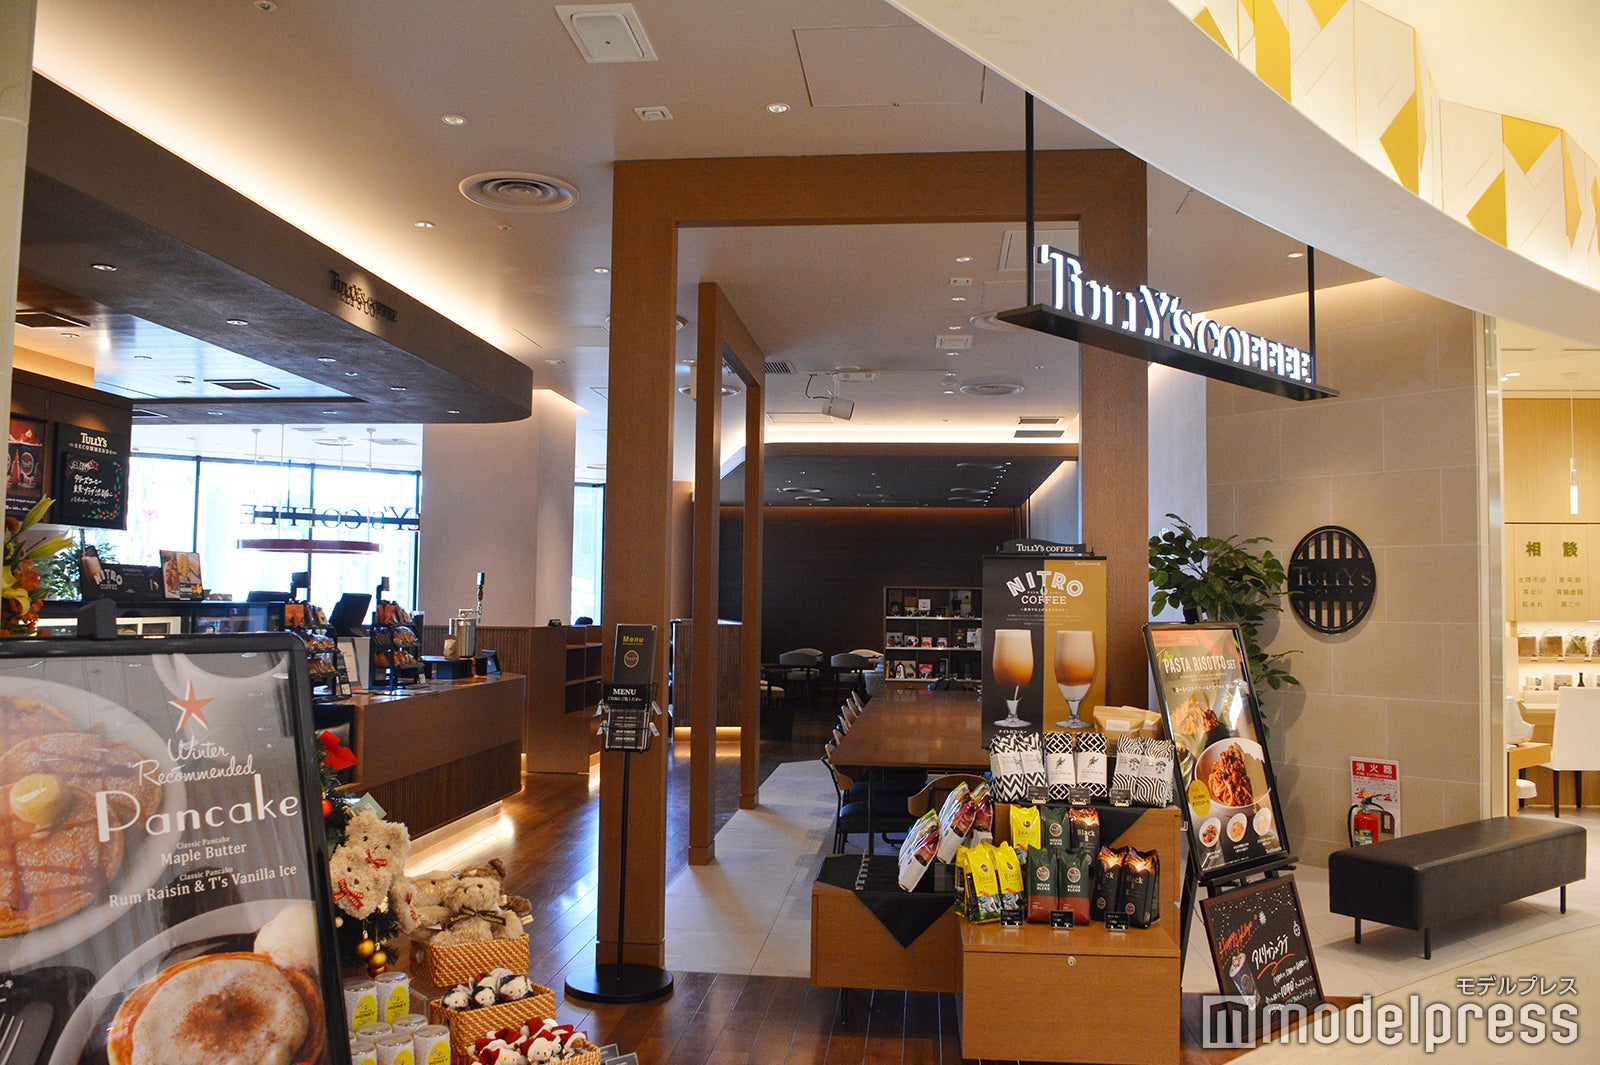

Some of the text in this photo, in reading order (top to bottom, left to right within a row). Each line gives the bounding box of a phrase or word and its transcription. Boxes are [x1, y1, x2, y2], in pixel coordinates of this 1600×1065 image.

[1038, 243, 1314, 384] TULLY'S COFFEE
[80, 432, 108, 448] TULLY'S
[1016, 543, 1075, 553] TULLY'S COFFEE
[1526, 541, 1578, 557] 相談
[1006, 571, 1084, 598] NITRO
[1021, 595, 1067, 605] COFFEE
[623, 635, 644, 643] Menu
[1164, 655, 1236, 673] PASTA RISOTTO SET
[613, 688, 637, 696] MENU
[168, 735, 229, 762] Winter
[132, 753, 256, 786] Recommended
[95, 773, 299, 842] Pancake
[1077, 829, 1096, 837] Black
[176, 835, 230, 850] Classic Pancake
[161, 843, 247, 867] Maple Butter
[179, 866, 233, 881] Classic Pancake
[109, 864, 298, 908] Rum Raisin & T's Vanilla Ice
